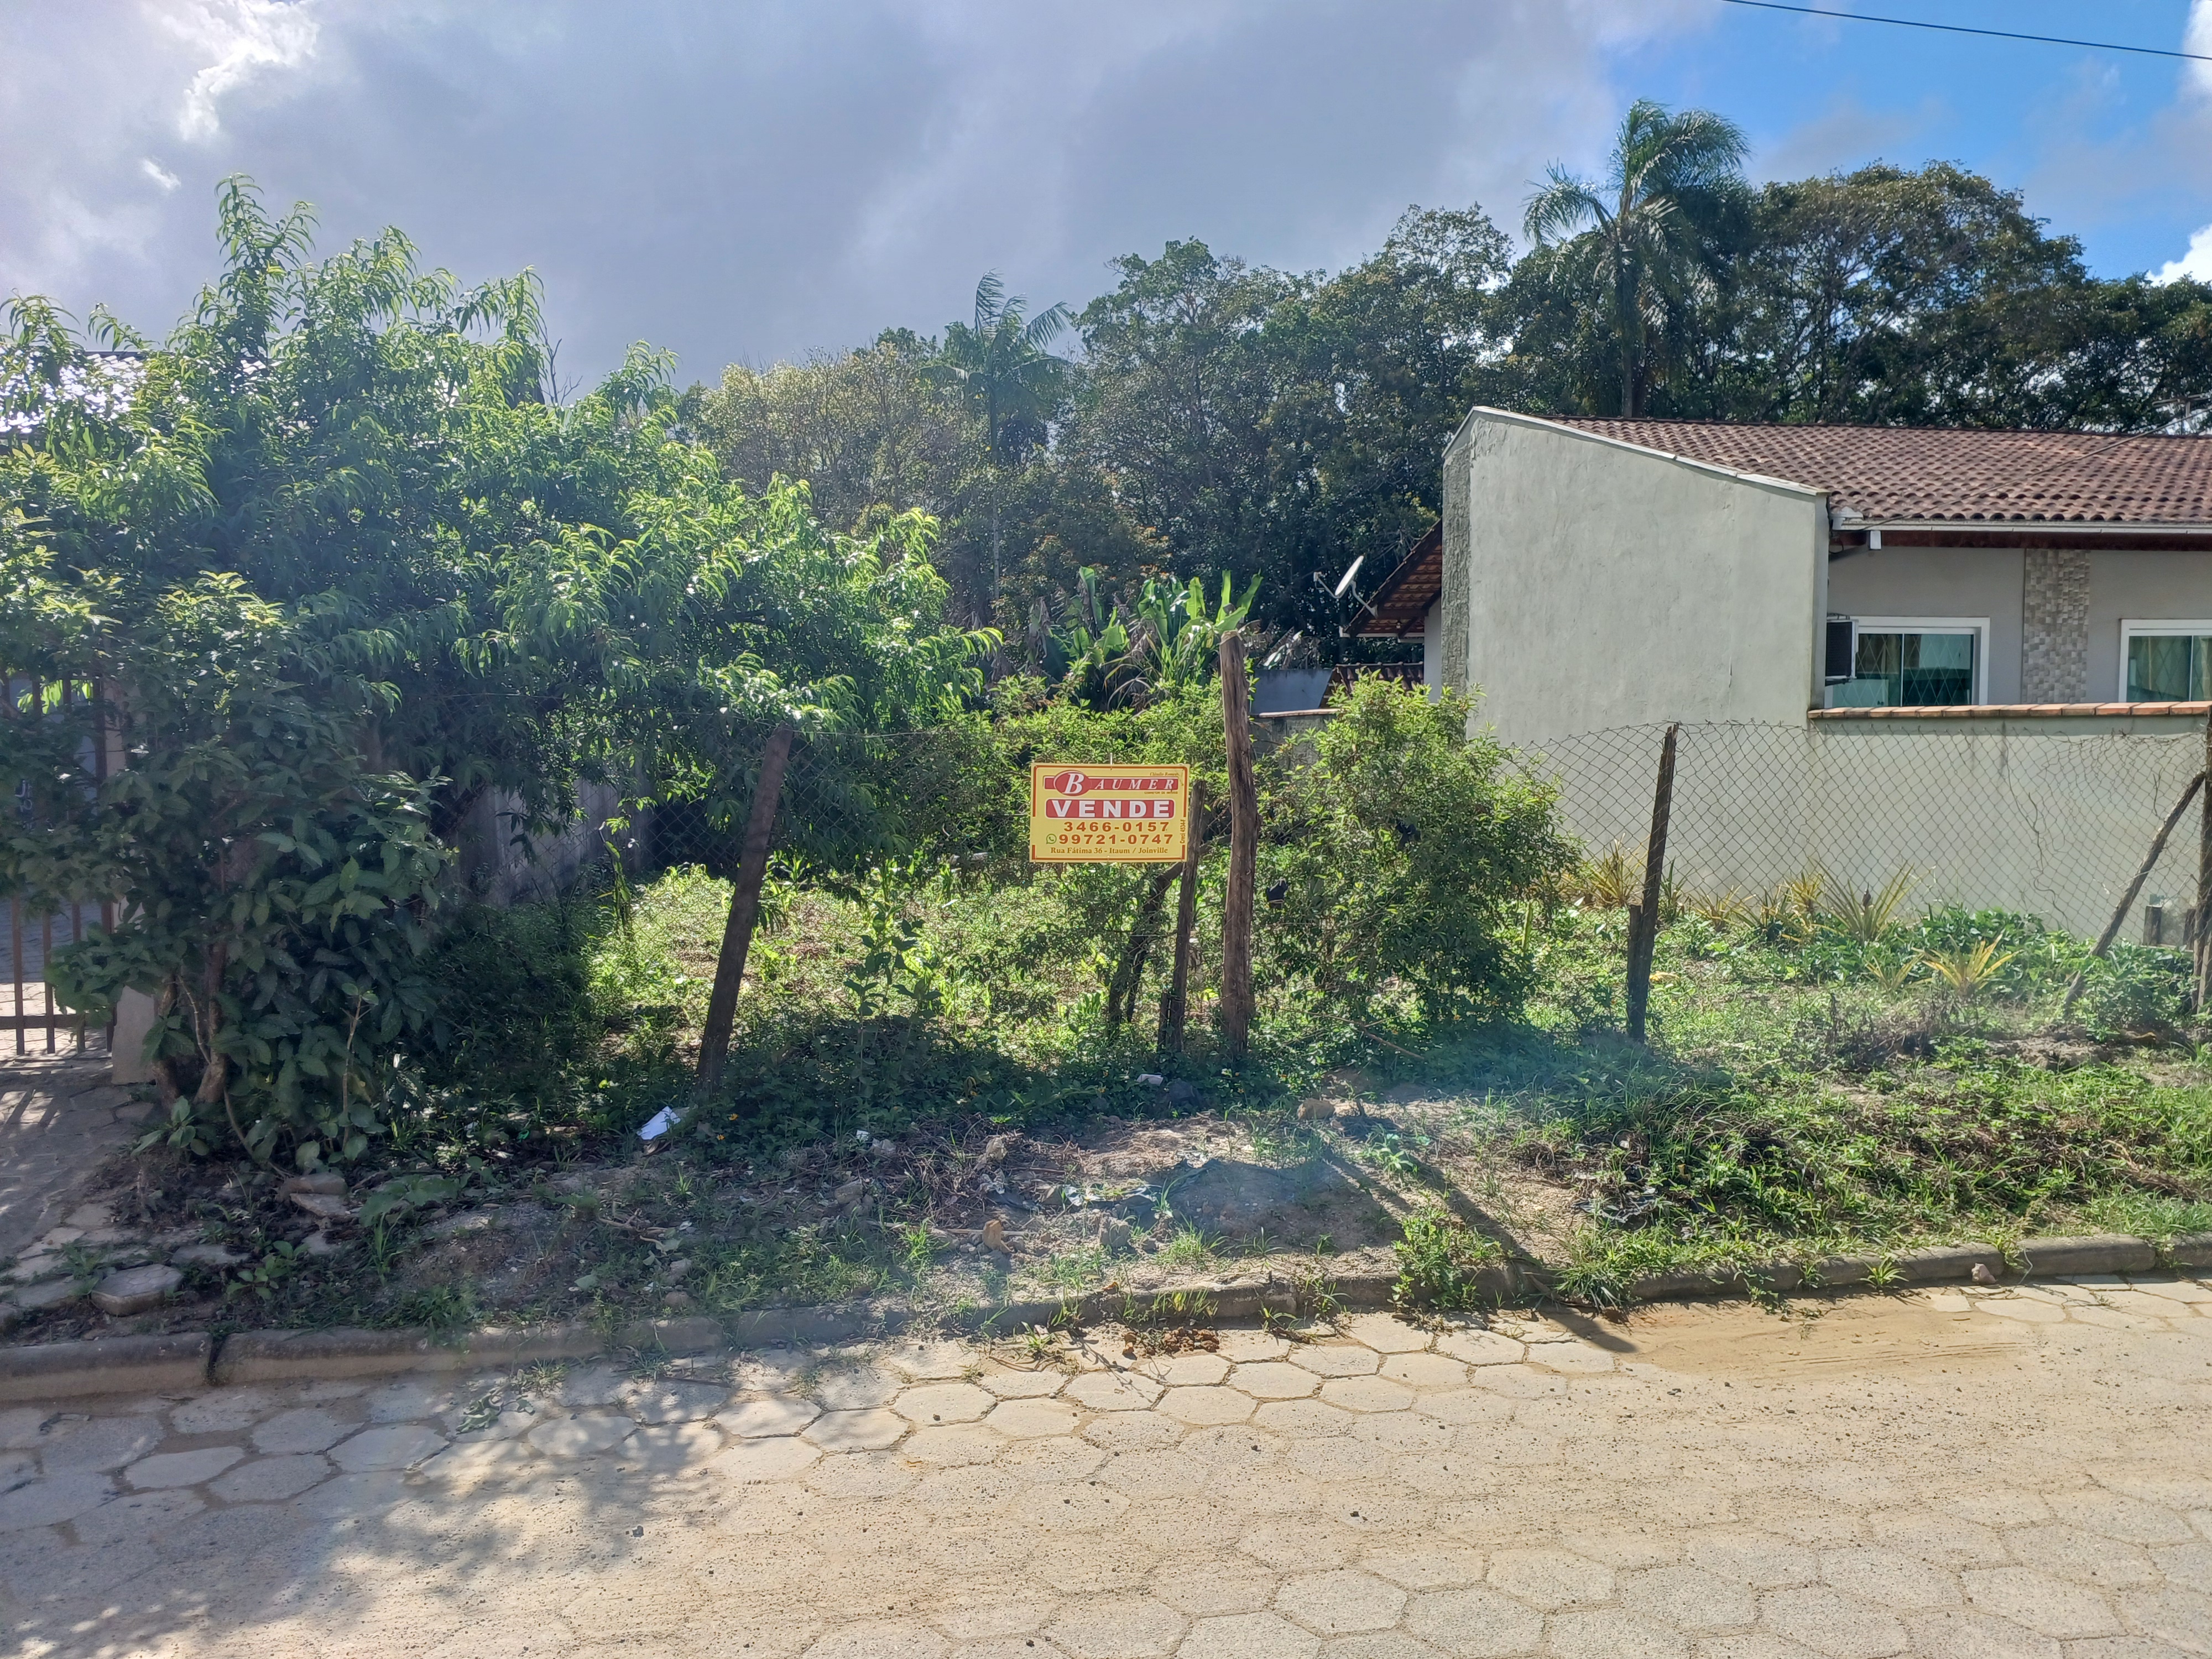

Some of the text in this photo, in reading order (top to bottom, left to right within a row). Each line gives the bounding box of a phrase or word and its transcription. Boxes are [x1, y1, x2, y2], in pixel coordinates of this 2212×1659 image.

[1062, 773, 1174, 794] BAUMER
[1052, 800, 1170, 817] VENDE
[1063, 822, 1169, 832] 3466-0157
[1059, 834, 1173, 844] 99721-0747
